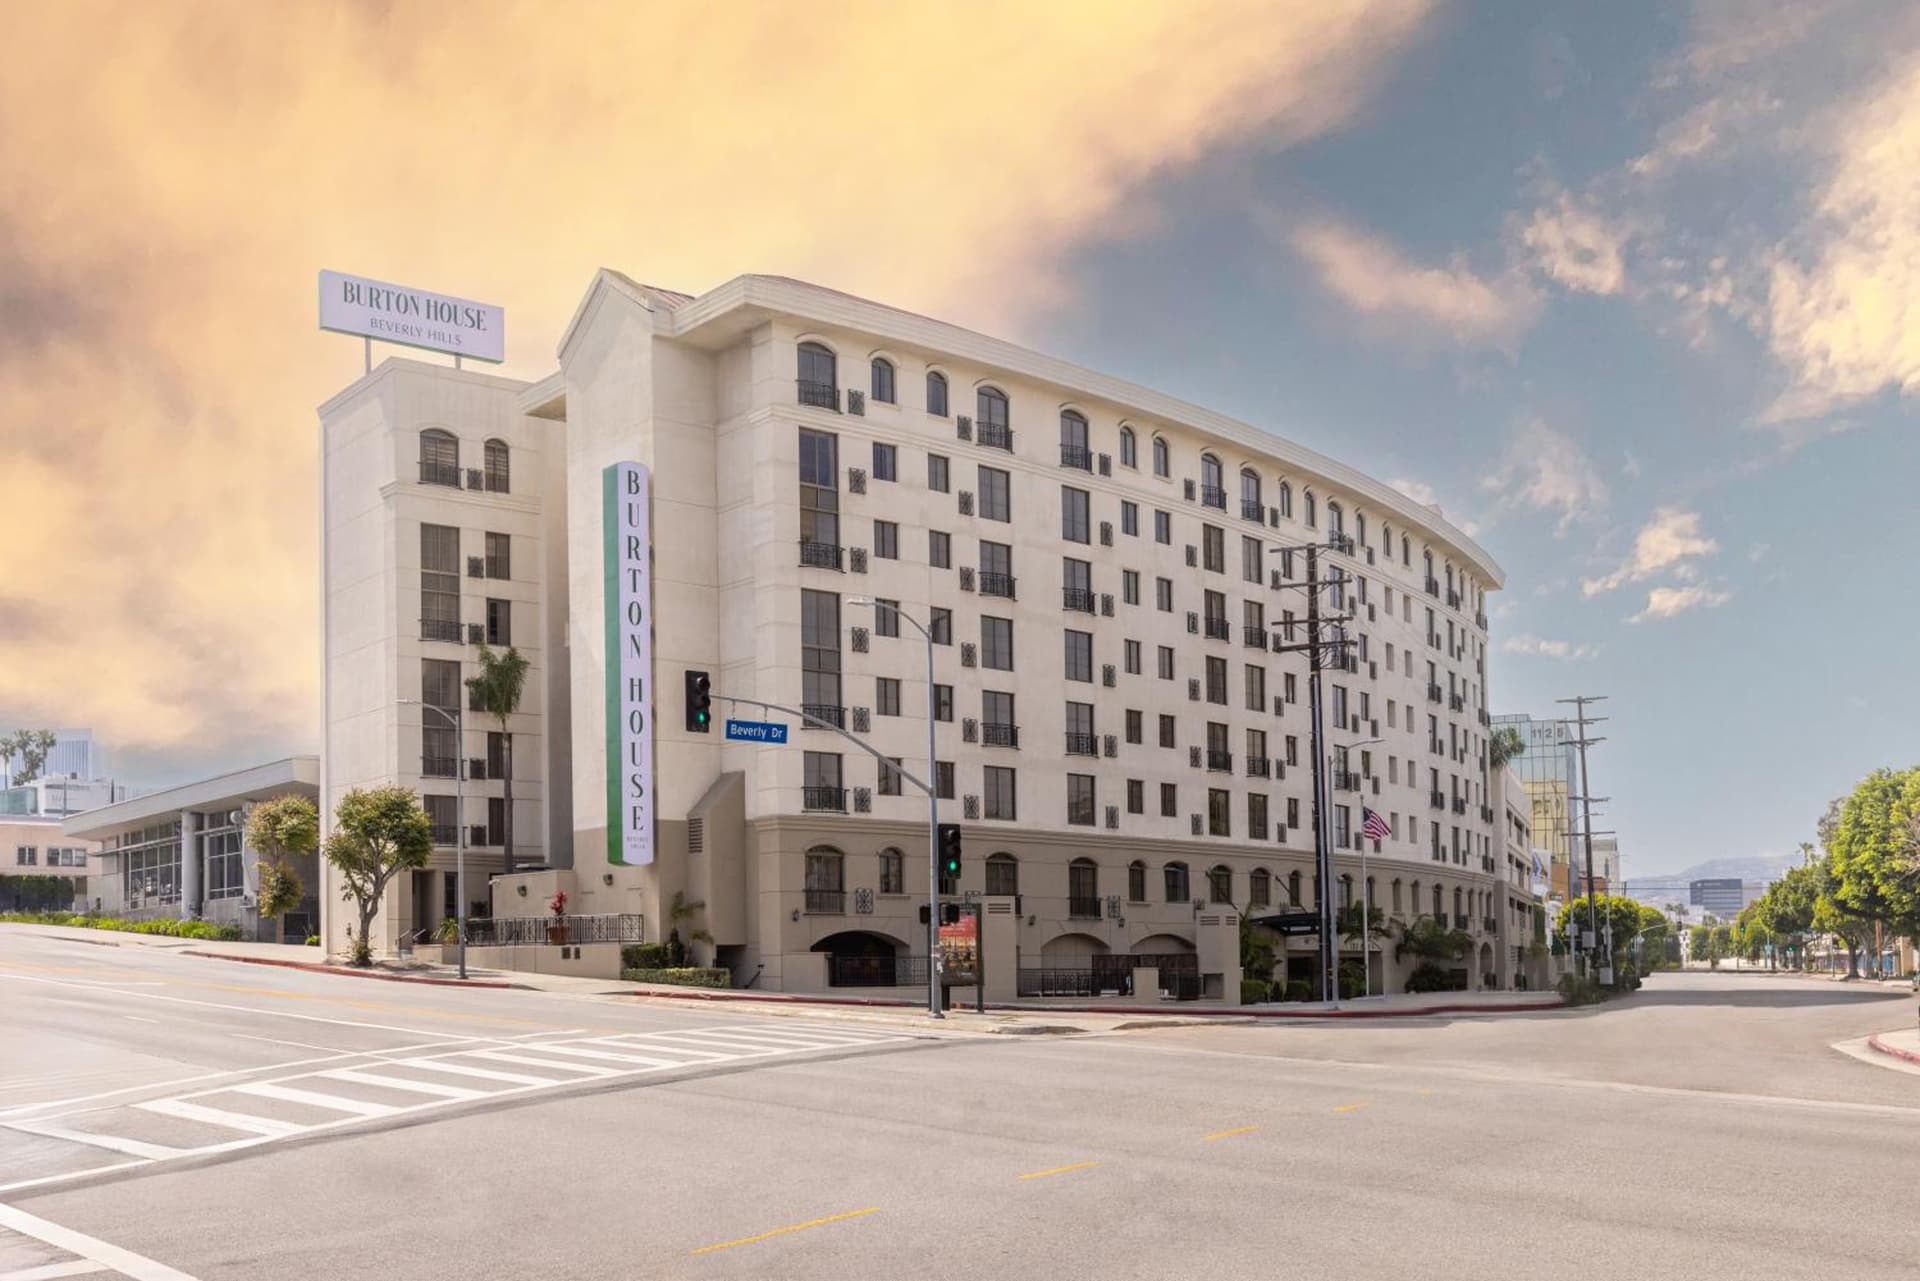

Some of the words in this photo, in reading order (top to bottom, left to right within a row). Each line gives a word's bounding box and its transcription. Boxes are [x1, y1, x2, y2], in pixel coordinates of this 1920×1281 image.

[343, 281, 420, 316] BURTON
[425, 298, 488, 331] HOUSE
[370, 317, 424, 338] BEVERLY
[427, 329, 462, 346] HILLS
[627, 469, 643, 660] BURTON
[629, 677, 645, 832] HOUSE
[730, 723, 768, 740] Beverly
[771, 727, 783, 739] Dr
